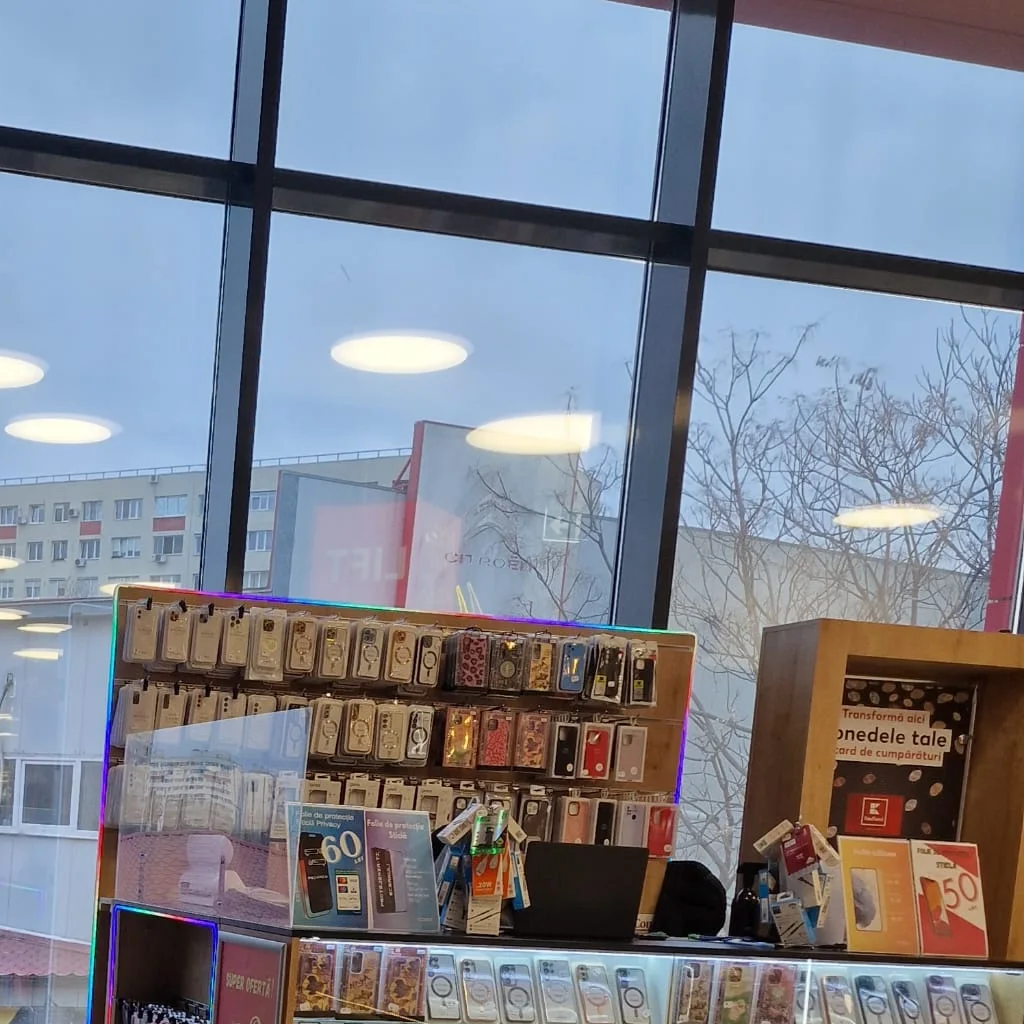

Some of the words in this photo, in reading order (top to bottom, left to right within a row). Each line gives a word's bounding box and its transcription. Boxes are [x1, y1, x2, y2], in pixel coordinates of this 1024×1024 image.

[842, 708, 904, 723] Transformă
[906, 713, 926, 724] aici
[912, 730, 947, 748] tale
[860, 746, 873, 757] de
[876, 749, 943, 763] cumpărături
[321, 830, 362, 864] 60
[942, 872, 978, 910] 50
[226, 971, 245, 990] SUPER
